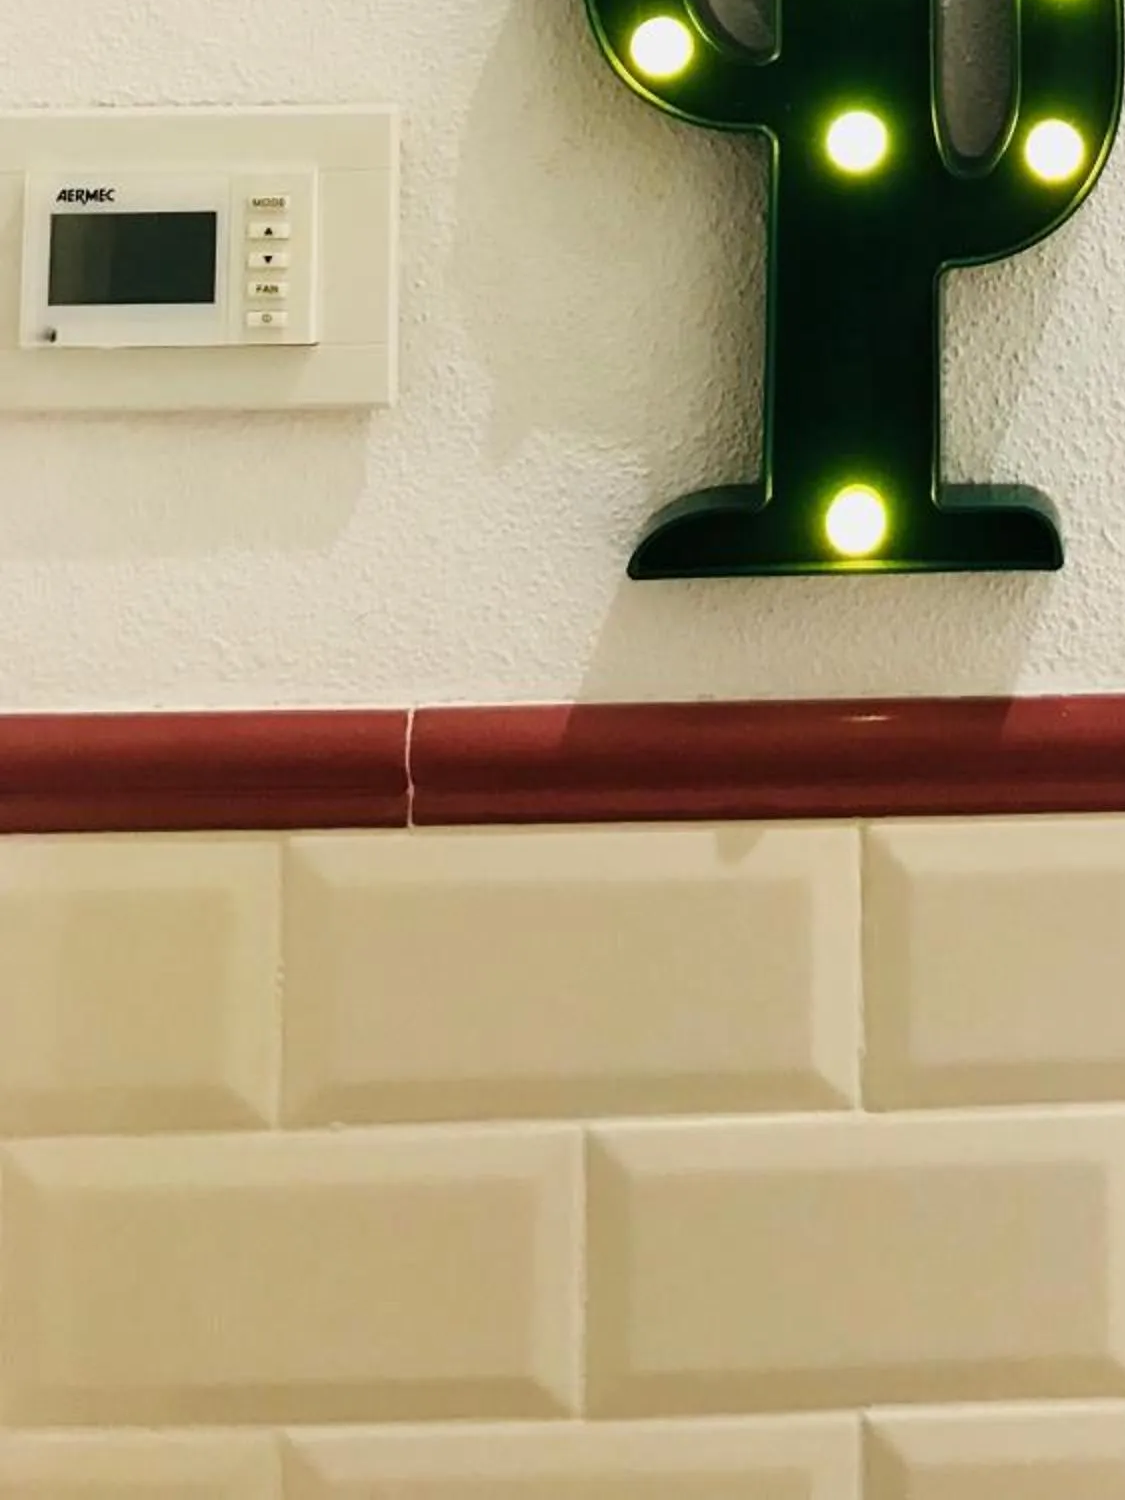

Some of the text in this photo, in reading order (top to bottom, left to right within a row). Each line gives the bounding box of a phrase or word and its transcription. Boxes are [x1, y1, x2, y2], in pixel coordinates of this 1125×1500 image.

[56, 186, 115, 205] AERMEC
[252, 197, 285, 208] MODE
[256, 283, 279, 294] FAN
